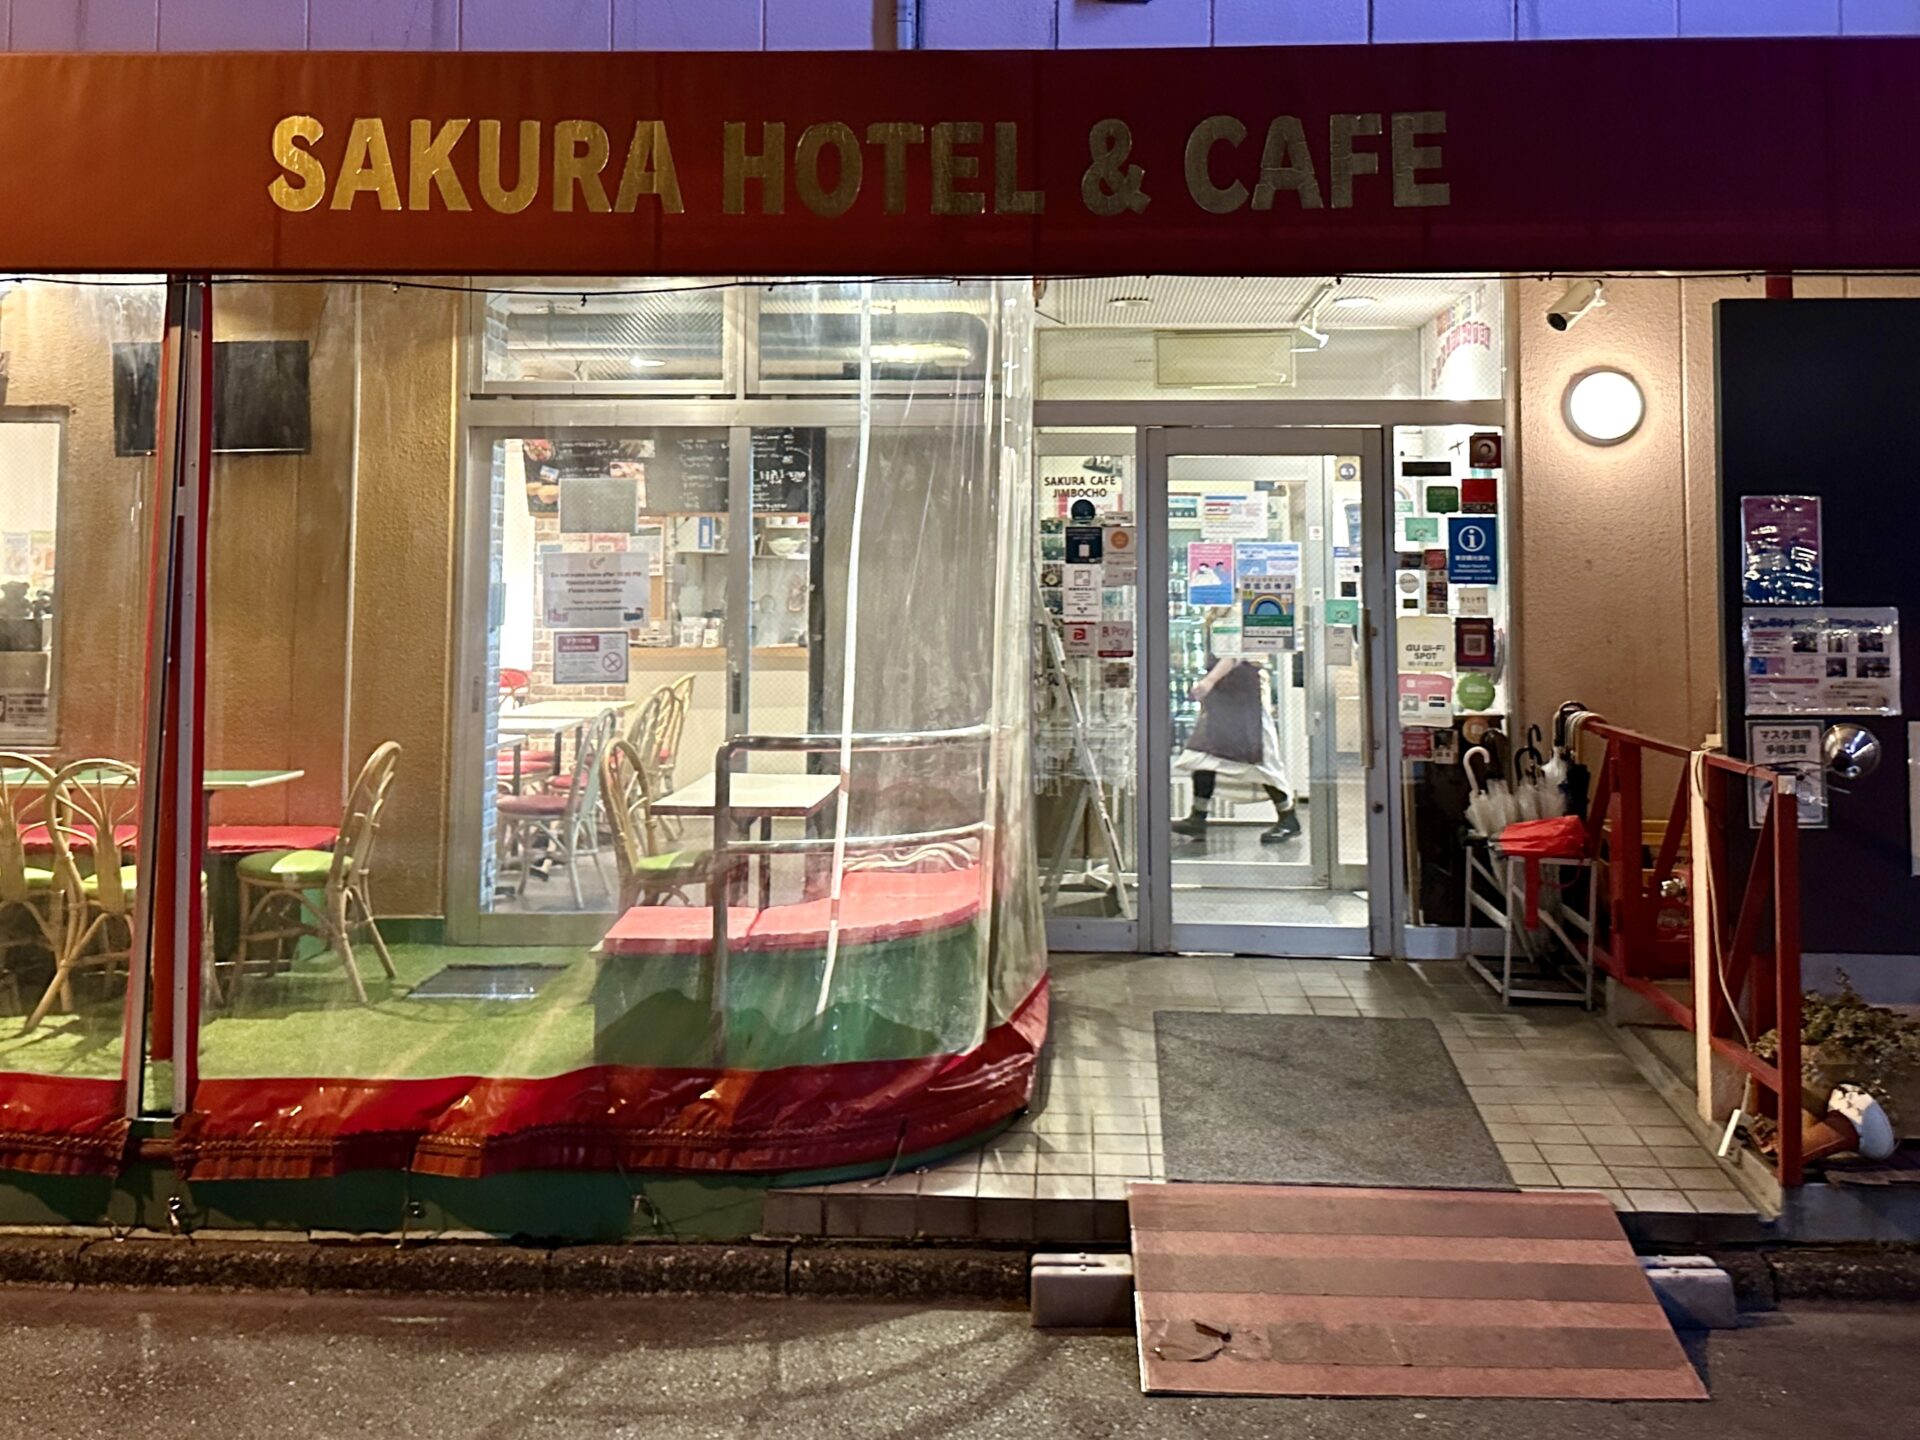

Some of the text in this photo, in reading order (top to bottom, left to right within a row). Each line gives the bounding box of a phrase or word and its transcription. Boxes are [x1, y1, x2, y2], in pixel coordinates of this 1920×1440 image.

[267, 111, 1451, 215] SAKURA HOTEL & CAFE
[1044, 476, 1086, 486] SAKURA
[1053, 488, 1107, 498] JIMBOCHO
[1413, 652, 1438, 660] SPOT
